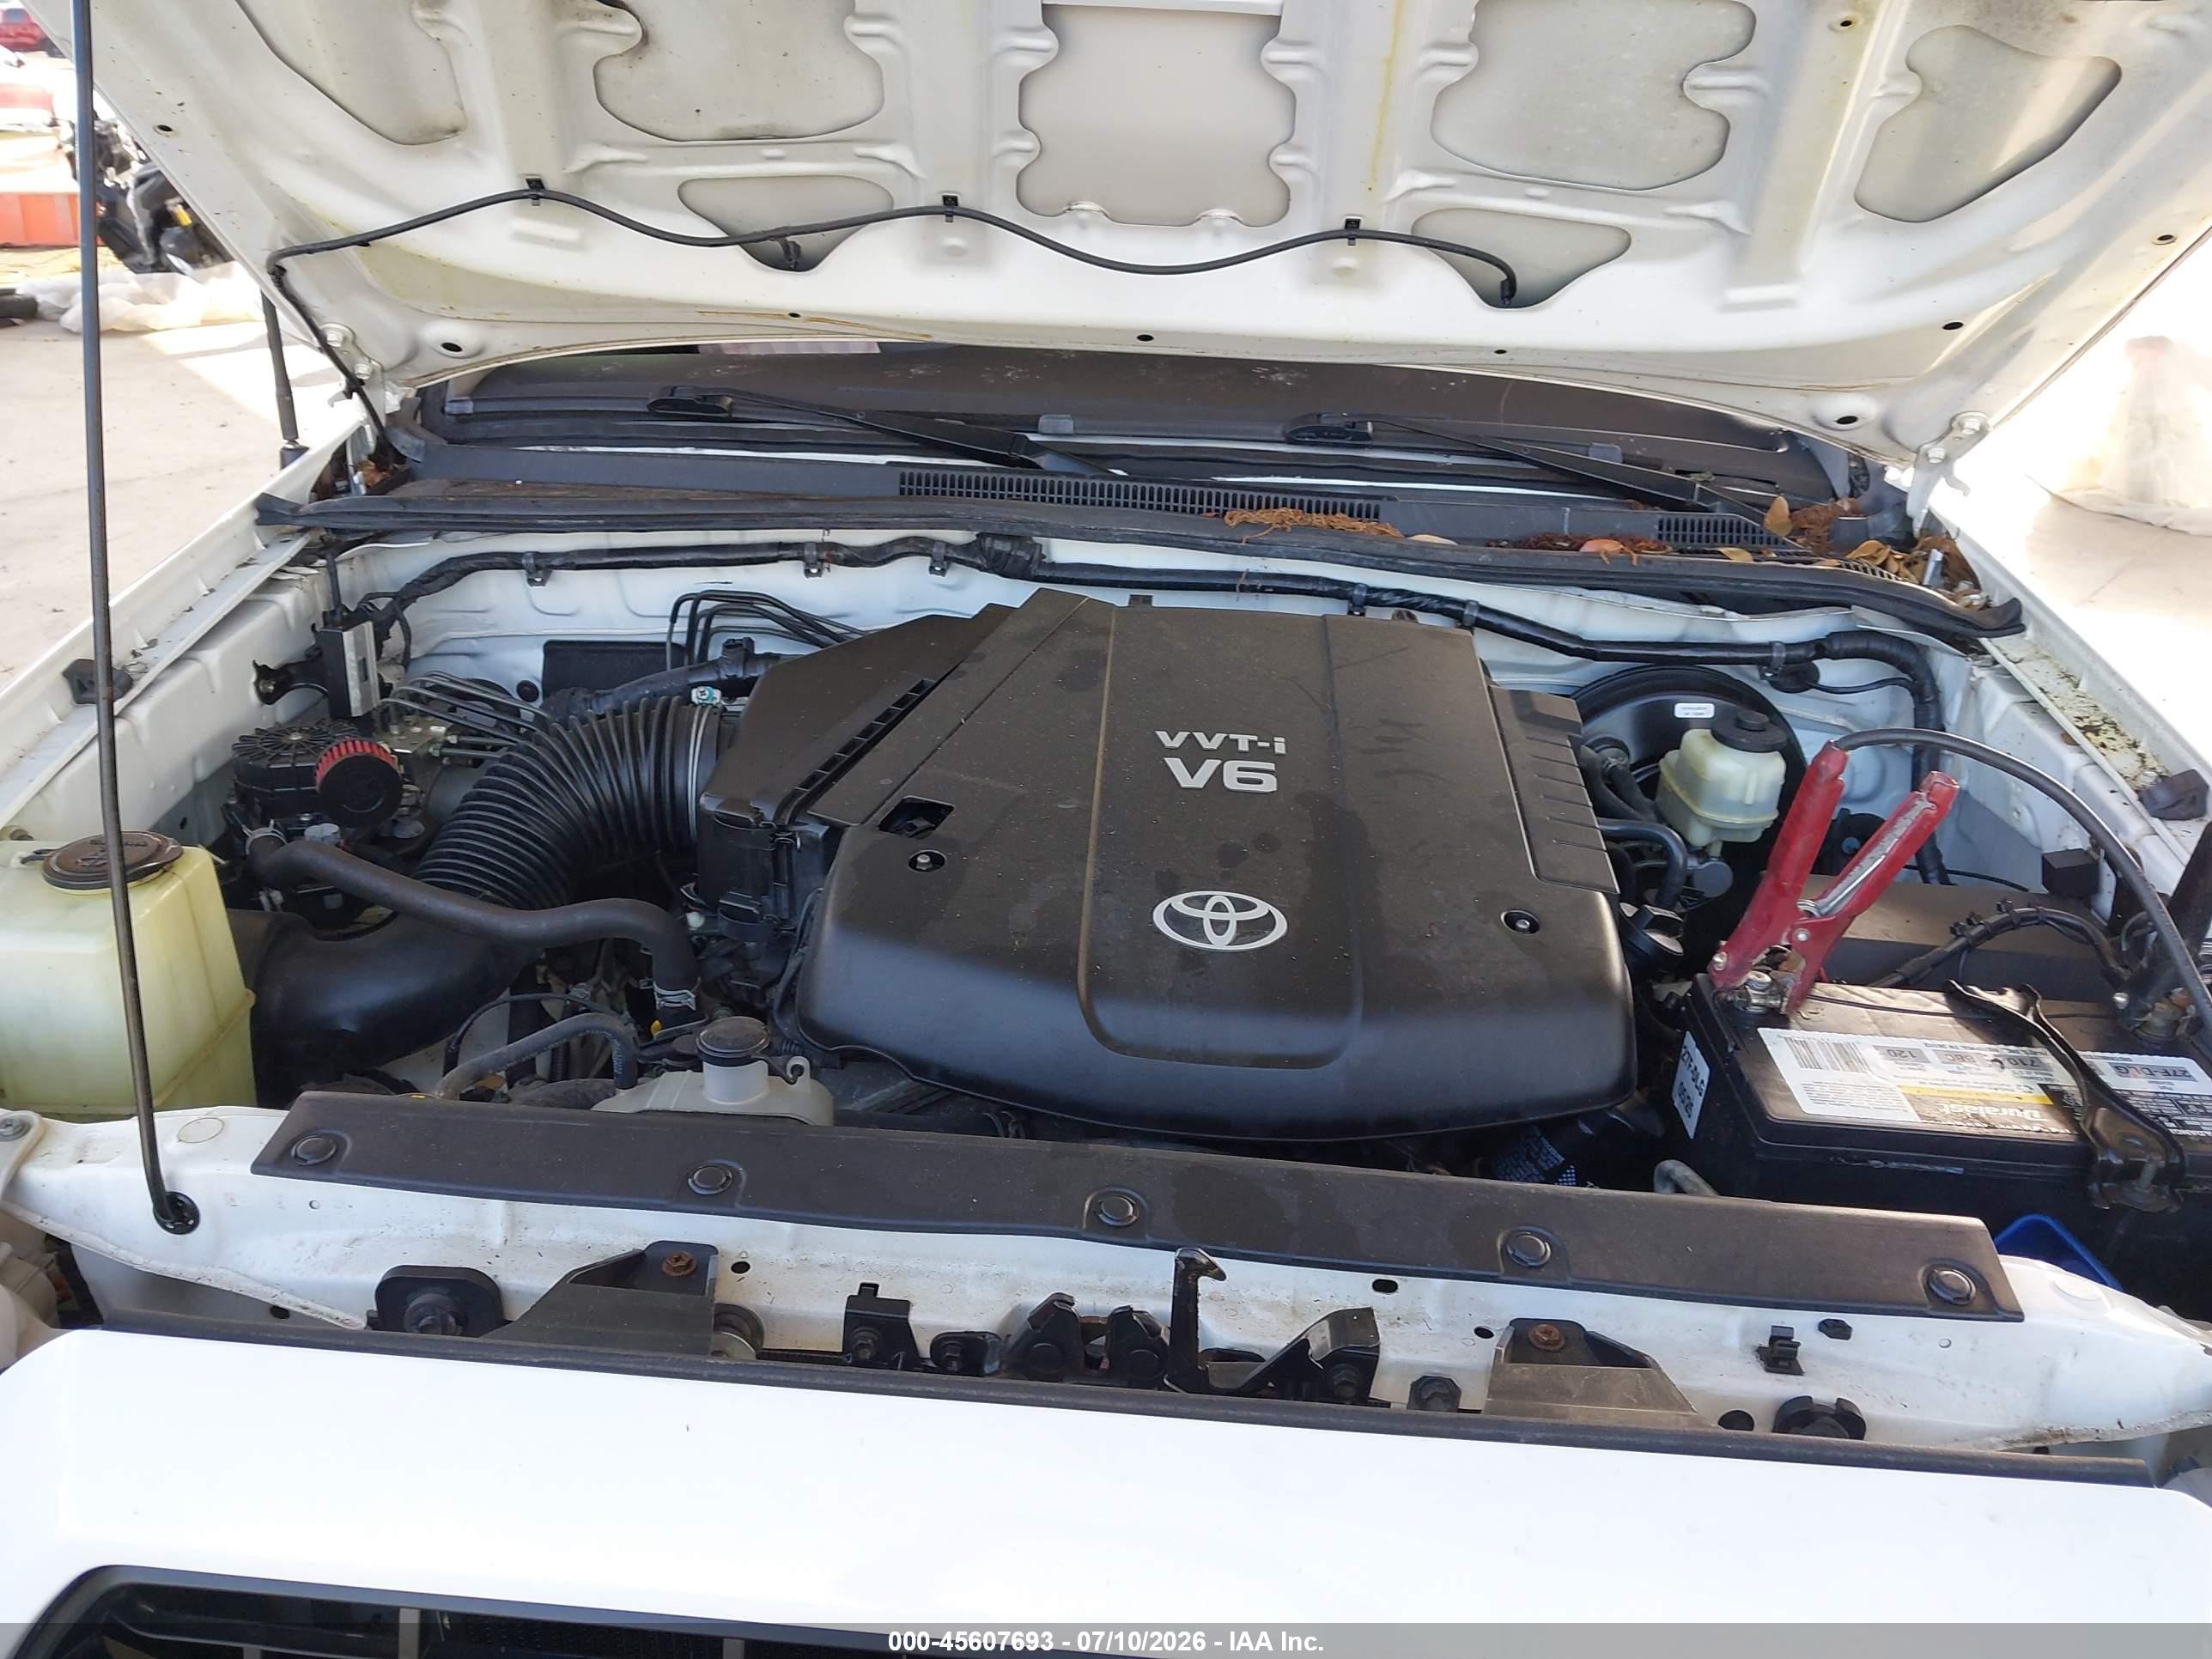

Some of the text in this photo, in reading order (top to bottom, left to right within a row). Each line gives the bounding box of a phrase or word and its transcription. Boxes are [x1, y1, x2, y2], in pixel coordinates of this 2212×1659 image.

[1154, 730, 1286, 755] VVT-i
[1164, 757, 1278, 793] V6
[1887, 1048, 1917, 1059] 120
[2007, 1058, 2041, 1067] 710
[2114, 1065, 2192, 1079] 27F-DLG
[1937, 1103, 2049, 1122] Duralast
